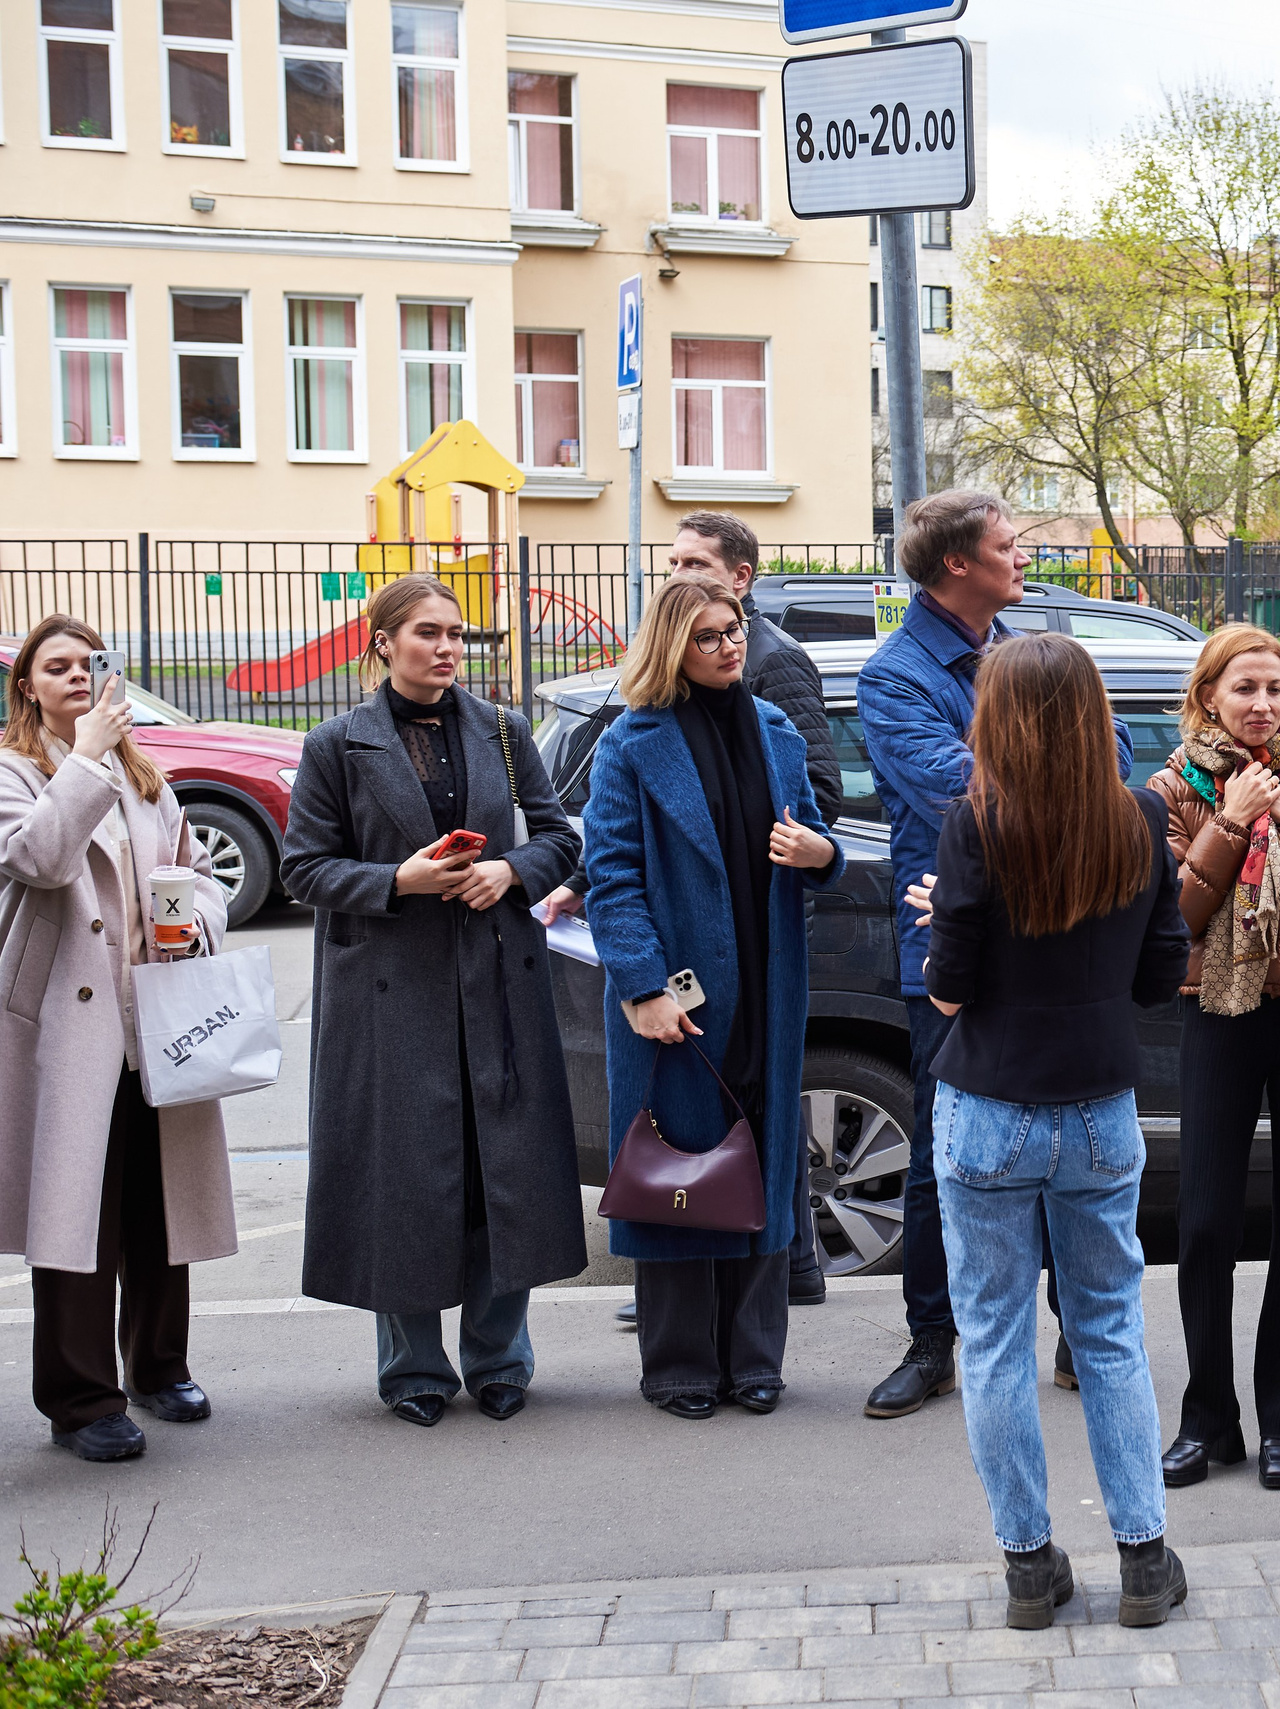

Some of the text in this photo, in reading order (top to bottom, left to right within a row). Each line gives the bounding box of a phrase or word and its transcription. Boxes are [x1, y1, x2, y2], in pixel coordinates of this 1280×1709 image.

[795, 102, 956, 164] 8.00-20.00
[623, 291, 637, 376] P
[165, 898, 181, 914] X
